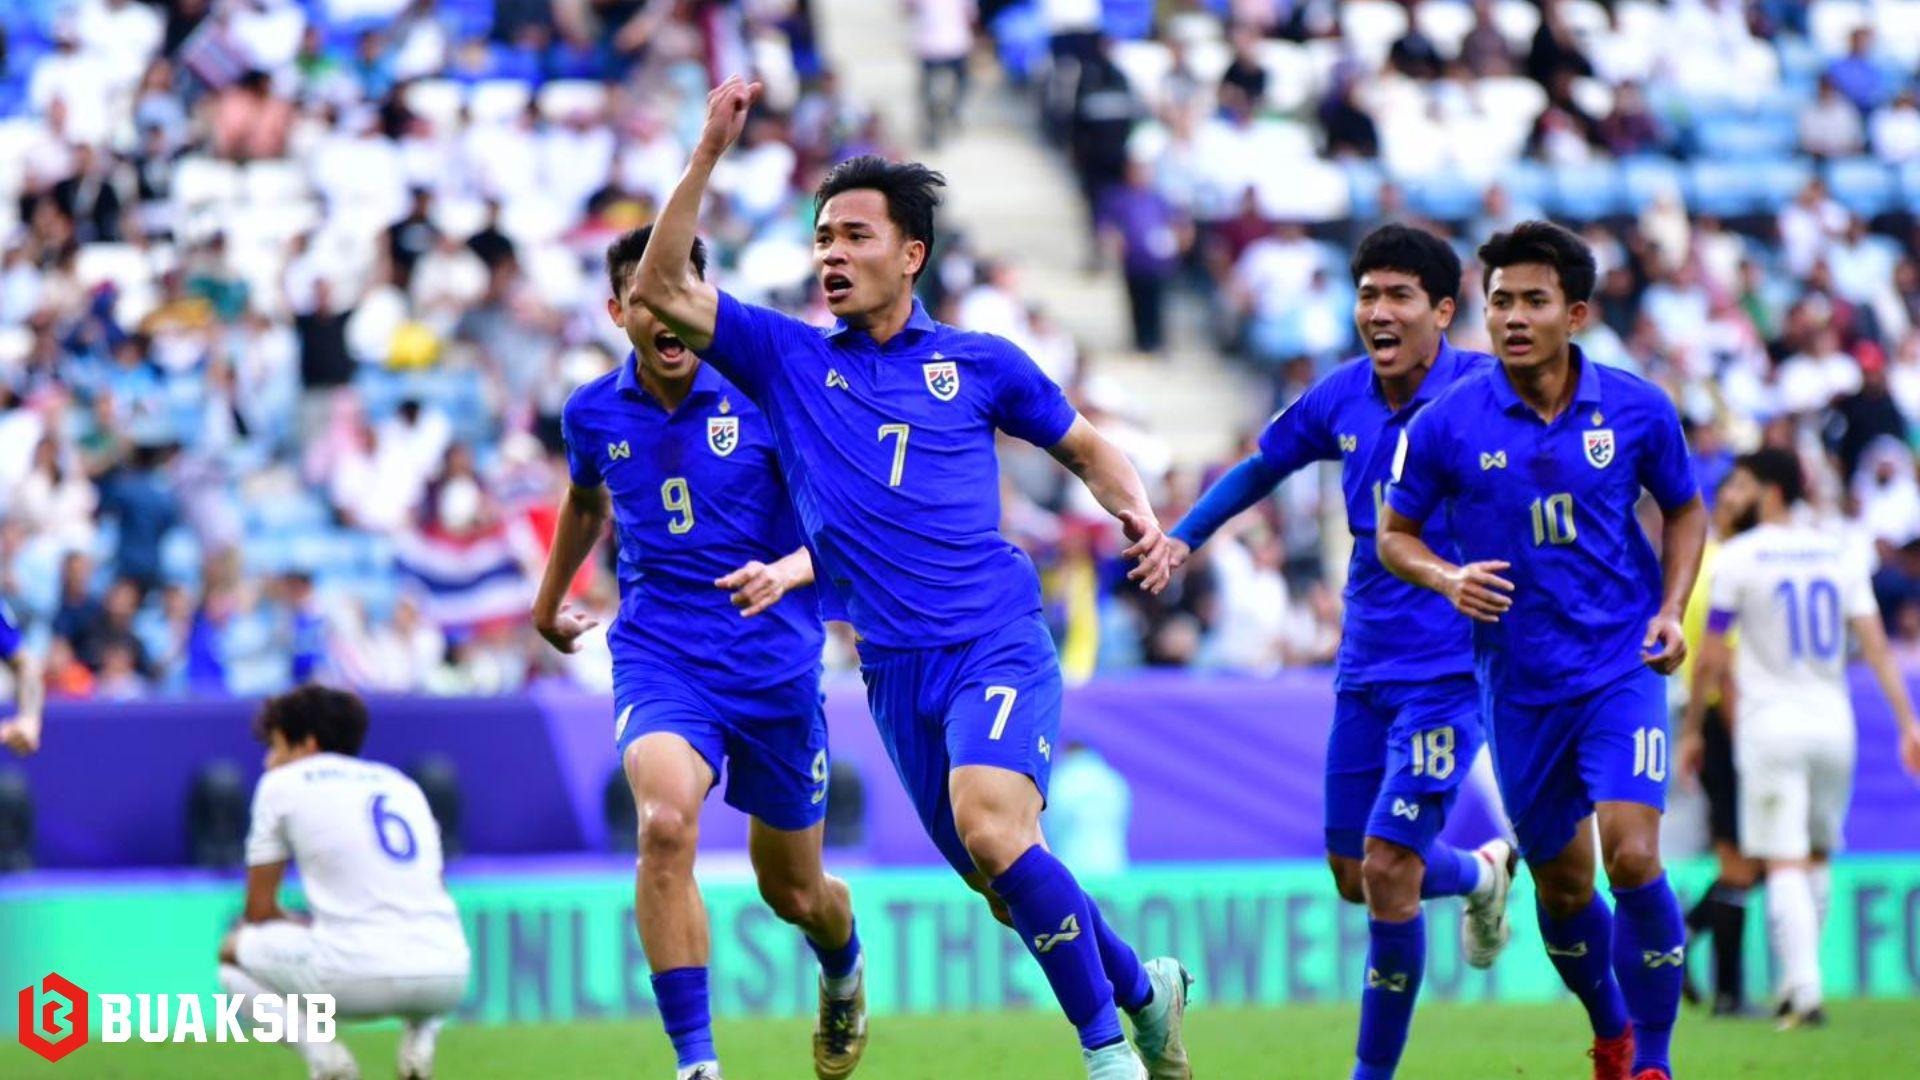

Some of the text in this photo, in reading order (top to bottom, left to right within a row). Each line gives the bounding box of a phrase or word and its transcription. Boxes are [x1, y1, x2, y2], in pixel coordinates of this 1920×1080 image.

[878, 423, 910, 487] 7
[660, 477, 695, 534] 9
[1529, 492, 1577, 547] 10
[1773, 577, 1841, 661] 10
[985, 685, 1018, 740] 7
[811, 748, 828, 805] 9
[1411, 725, 1455, 780] 18
[1632, 727, 1666, 782] 10
[372, 792, 418, 862] 6
[457, 902, 818, 1020] NLES
[1097, 889, 1370, 1004] OWER
